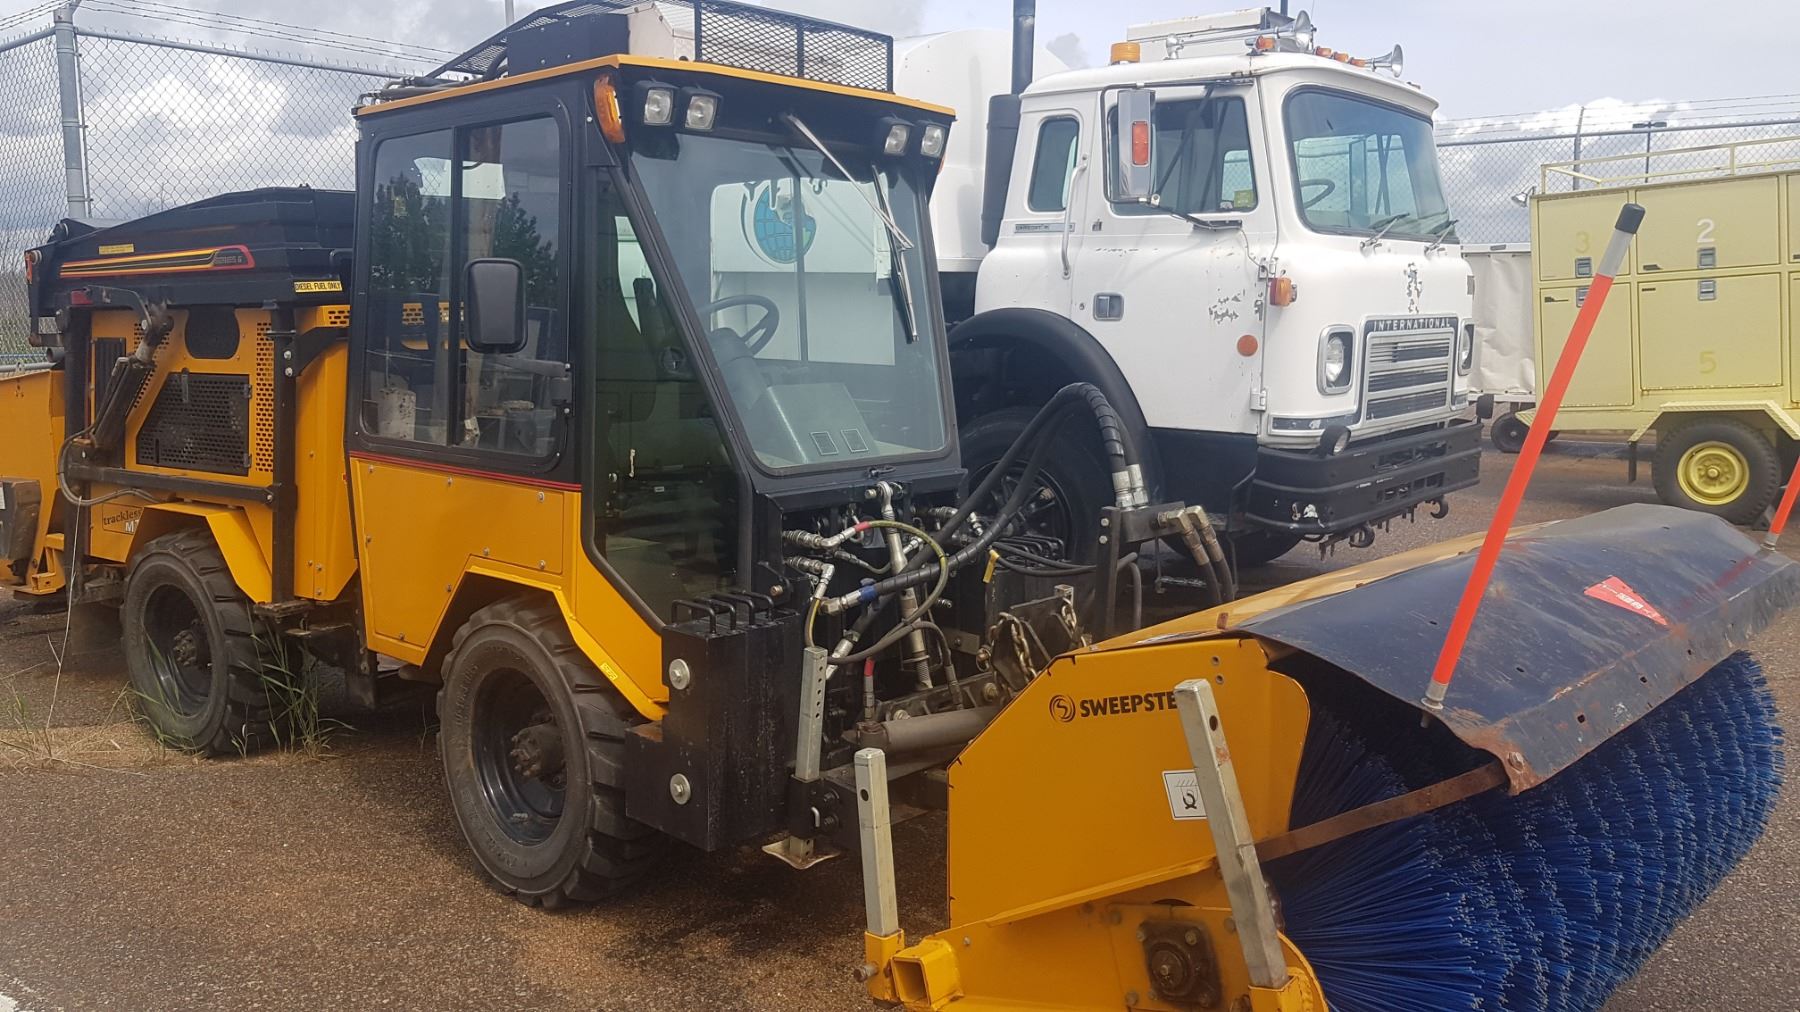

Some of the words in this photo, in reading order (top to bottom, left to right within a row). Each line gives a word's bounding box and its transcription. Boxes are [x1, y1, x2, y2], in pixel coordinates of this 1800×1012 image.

[1696, 218, 1716, 243] 2
[1574, 231, 1590, 253] 3
[314, 281, 327, 290] FUEL
[328, 281, 341, 290] ONLY
[1373, 318, 1451, 332] INTERNATIONAL
[1699, 351, 1717, 374] 5
[1079, 691, 1178, 718] SWEEPSTE
